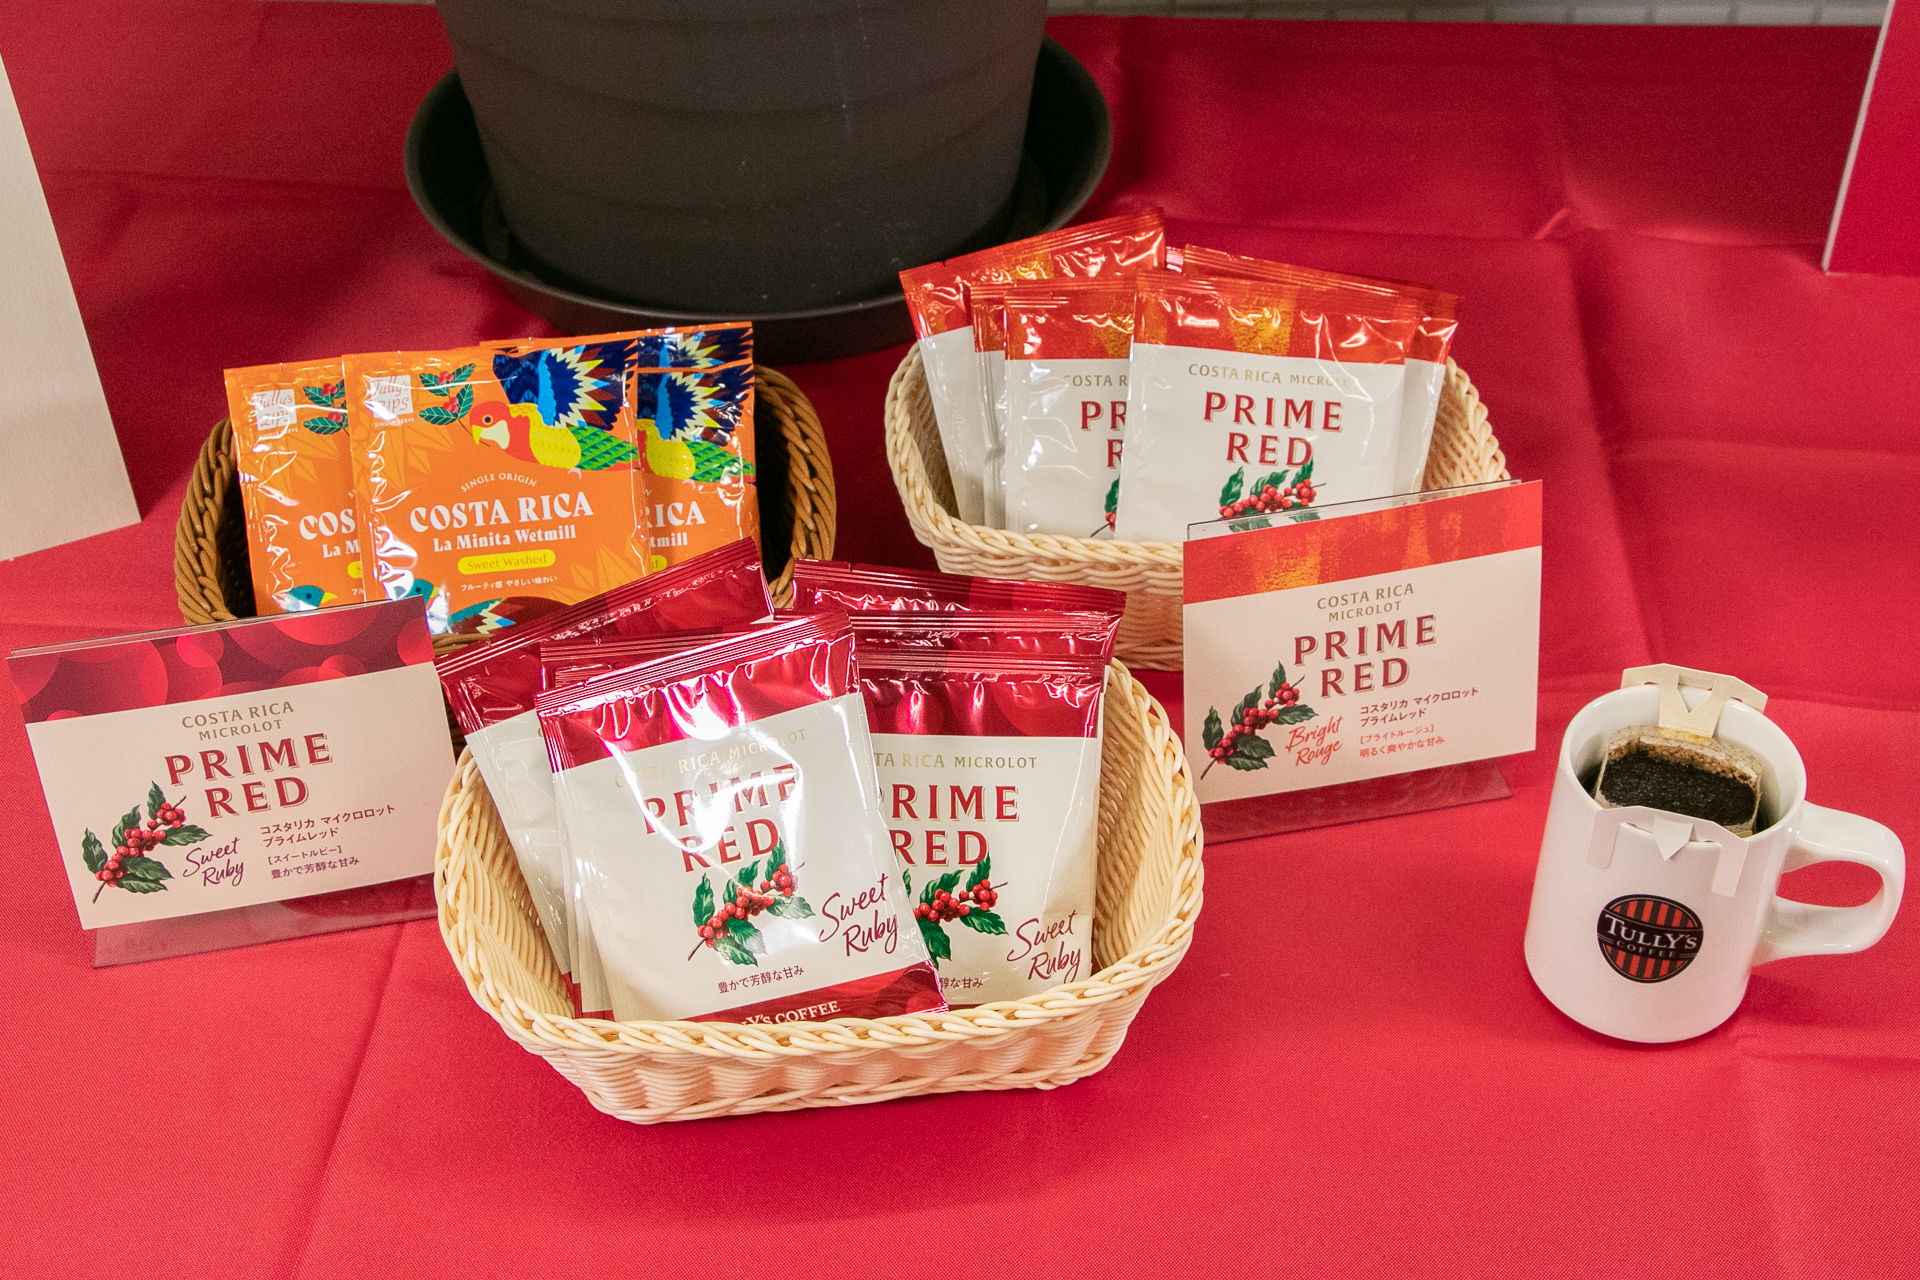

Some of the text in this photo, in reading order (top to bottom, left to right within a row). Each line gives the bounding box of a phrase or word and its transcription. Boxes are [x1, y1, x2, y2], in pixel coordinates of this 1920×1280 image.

[1189, 363, 1352, 388] COSTA RICA MICROLO
[1203, 391, 1343, 432] PRIME
[1226, 432, 1314, 468] RED
[460, 472, 538, 493] SINGLE ORIGIN
[299, 508, 356, 540] COS
[409, 491, 594, 533] COSTA RICA
[322, 544, 341, 558] La
[433, 524, 577, 552] La Minita Wetmill
[649, 532, 688, 548] tmill
[467, 553, 547, 571] Sweet Washed
[1316, 582, 1414, 610] COSTA RICA
[1328, 601, 1402, 622] MICROLOT
[1293, 614, 1437, 667] PRIME
[1320, 657, 1410, 699] RED
[182, 701, 294, 728] COSTA RICA
[1360, 687, 1479, 715] コスタリカ マイクロロット
[199, 719, 282, 741] MICROLOT
[1360, 708, 1427, 727] プライムレッド
[1285, 715, 1344, 753] Bright
[1359, 736, 1445, 758] 明るく爽やかな甘み
[164, 732, 332, 786] PRIME
[614, 763, 673, 788] CSTA
[677, 750, 721, 774] RICA
[902, 754, 945, 769] RICA
[954, 756, 1038, 769] MICROLOT
[1295, 740, 1342, 767] Rouge
[204, 776, 309, 819] RED
[880, 784, 1019, 822] RIME
[260, 804, 396, 835] コスタリカ マイクロロット
[262, 826, 340, 848] プライムレッド
[678, 817, 779, 873] RED
[889, 829, 988, 867] RED
[183, 836, 240, 877] Sweet
[270, 857, 360, 880] 豊かで芳醇な甘み
[201, 858, 244, 887] Ruby
[818, 872, 889, 943] Sweet
[842, 909, 898, 957] Ruby
[1006, 909, 1078, 962] Sweet
[1604, 914, 1697, 950] TULLY'S
[1028, 940, 1081, 984] Ruby
[1616, 939, 1677, 958] COFFEE
[717, 964, 805, 995] 豊かで芳醇な甘み
[775, 1000, 841, 1025] COFFEE
